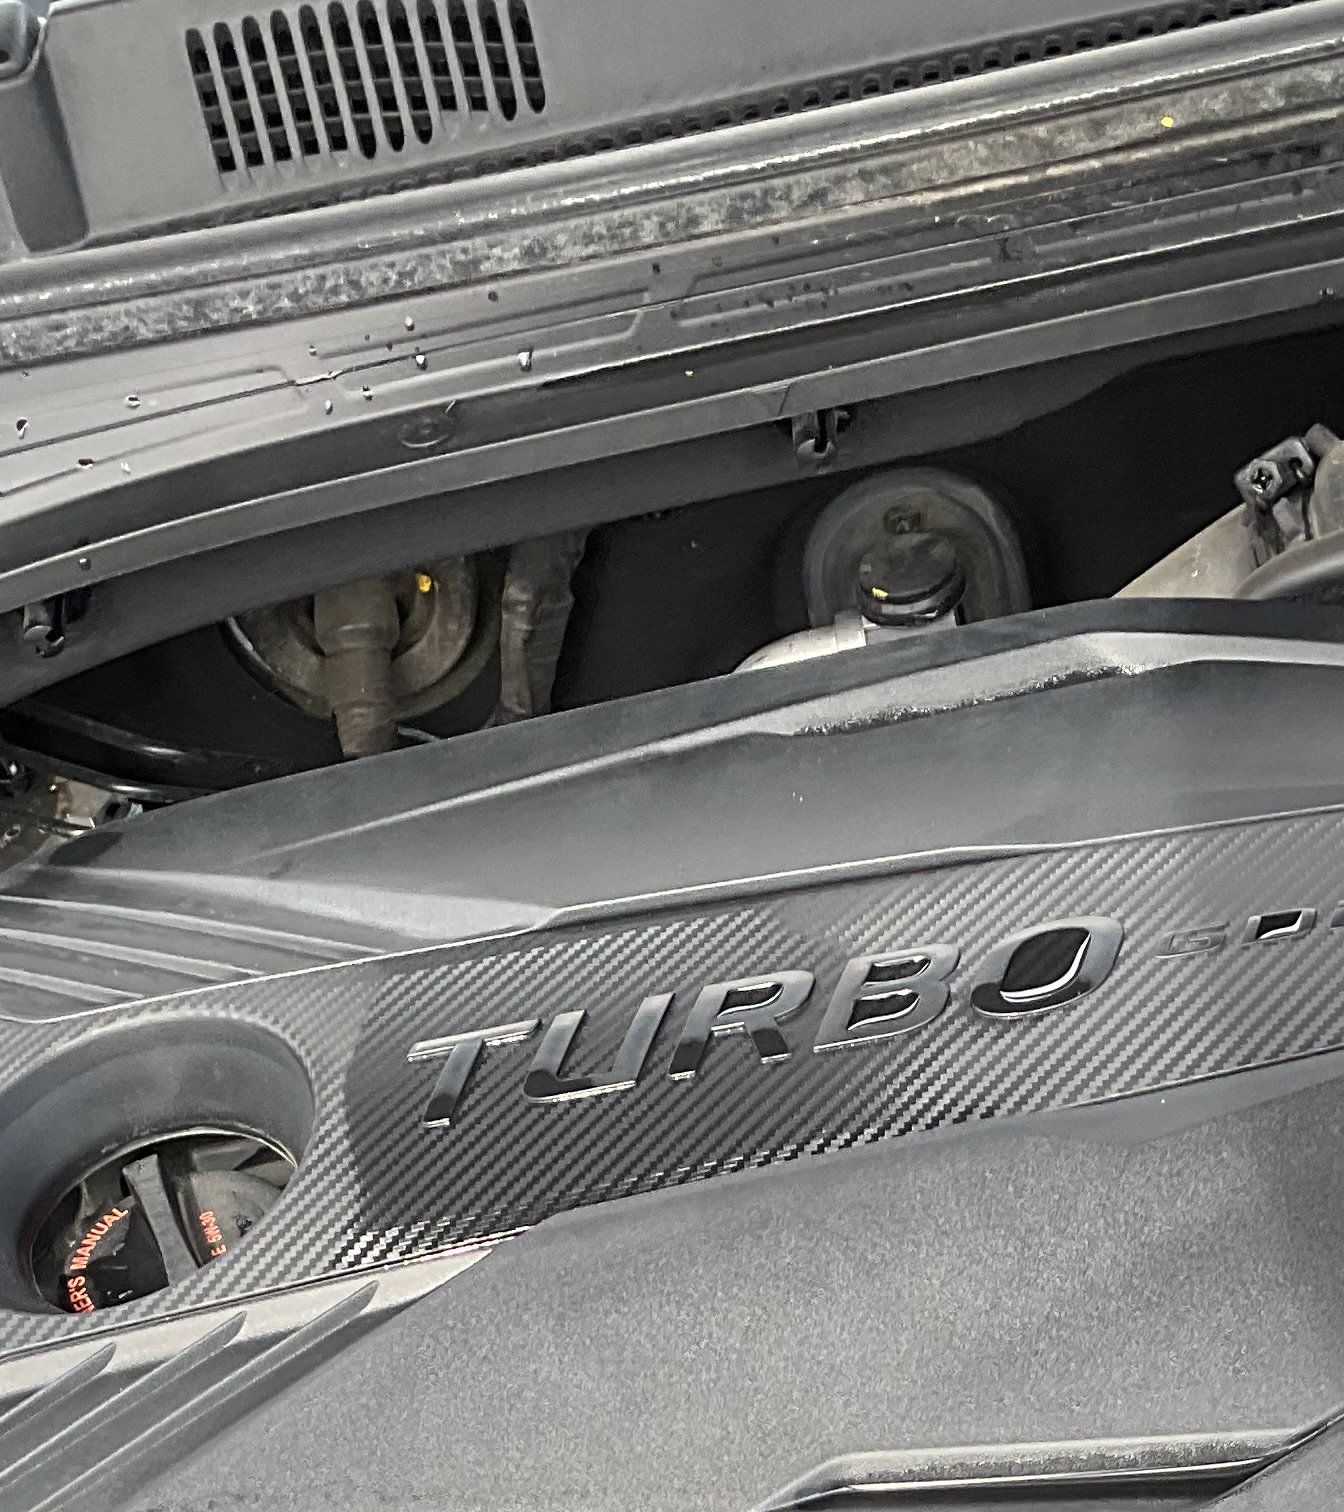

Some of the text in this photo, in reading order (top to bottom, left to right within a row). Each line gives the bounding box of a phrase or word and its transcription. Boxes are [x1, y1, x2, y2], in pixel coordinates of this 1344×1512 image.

[406, 915, 1123, 1128] TURBO
[67, 1207, 129, 1313] ER'S MANUAL
